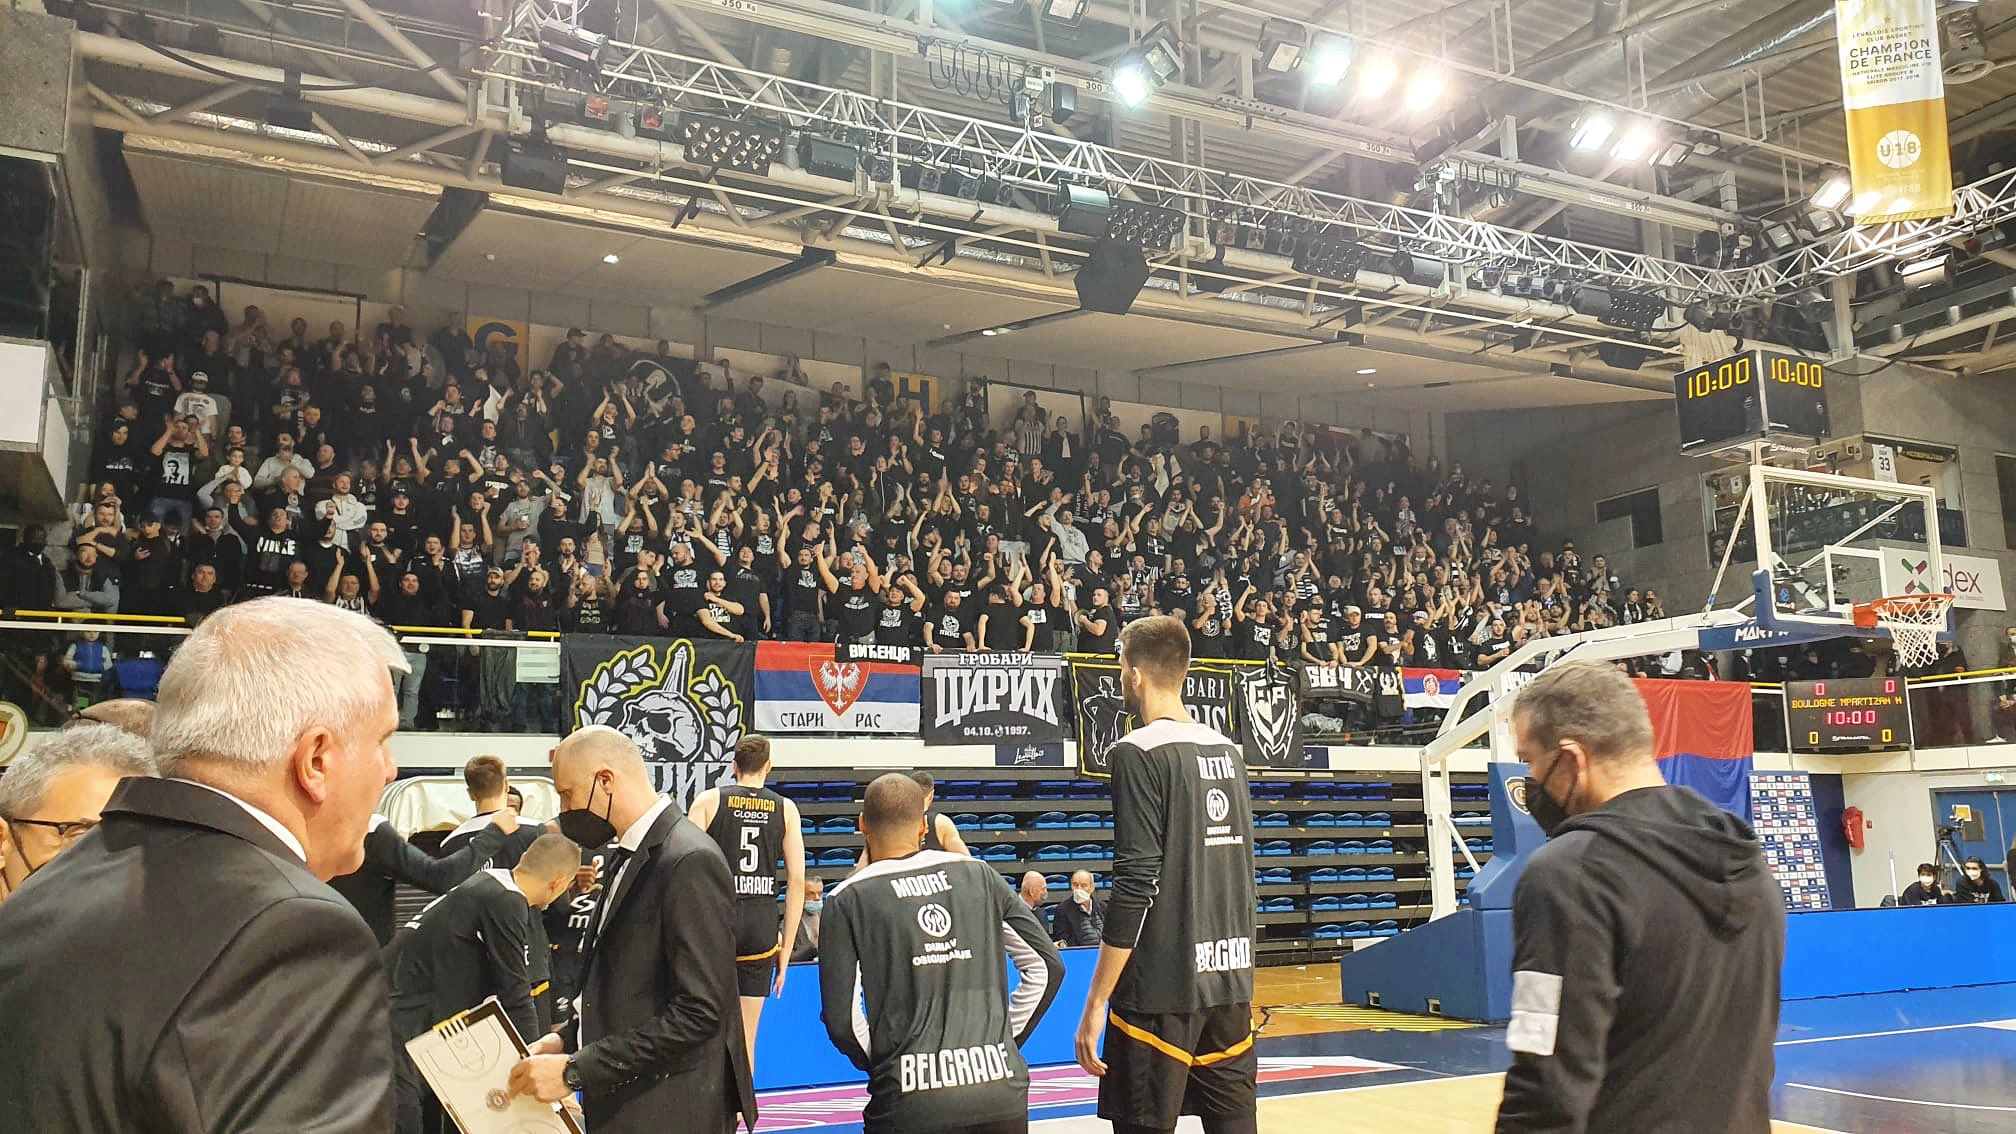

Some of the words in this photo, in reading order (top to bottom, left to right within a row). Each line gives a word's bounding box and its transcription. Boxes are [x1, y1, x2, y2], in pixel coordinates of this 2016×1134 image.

[1850, 38, 1930, 58] CHAMPION
[1850, 58, 1869, 69] DE
[1875, 49, 1933, 66] FRANCE
[1880, 141, 1917, 157] U18
[1688, 357, 1750, 399] 10:00
[1771, 358, 1823, 388] 10:00
[1878, 456, 1891, 471] 33
[959, 652, 1033, 666] ГРОБАРИ
[1186, 676, 1225, 699] BARI
[1815, 682, 1825, 696] 0
[1885, 679, 1895, 693] 0
[934, 668, 1059, 729] ЦИРИХ
[1792, 698, 1836, 709] BOULOGNE
[780, 711, 824, 728] СТАРИ
[855, 712, 881, 729] РАС
[1827, 710, 1876, 725] 10:00
[1809, 731, 1819, 744] 0
[1882, 728, 1892, 742] 0
[728, 795, 775, 813] KOPRIVICA
[733, 809, 769, 820] GLOBOS
[739, 826, 760, 873] 5
[735, 875, 775, 895] LGRADE
[890, 870, 953, 899] MOORE
[924, 938, 957, 953] DUNAV
[900, 1042, 1015, 1093] BELGRADE
